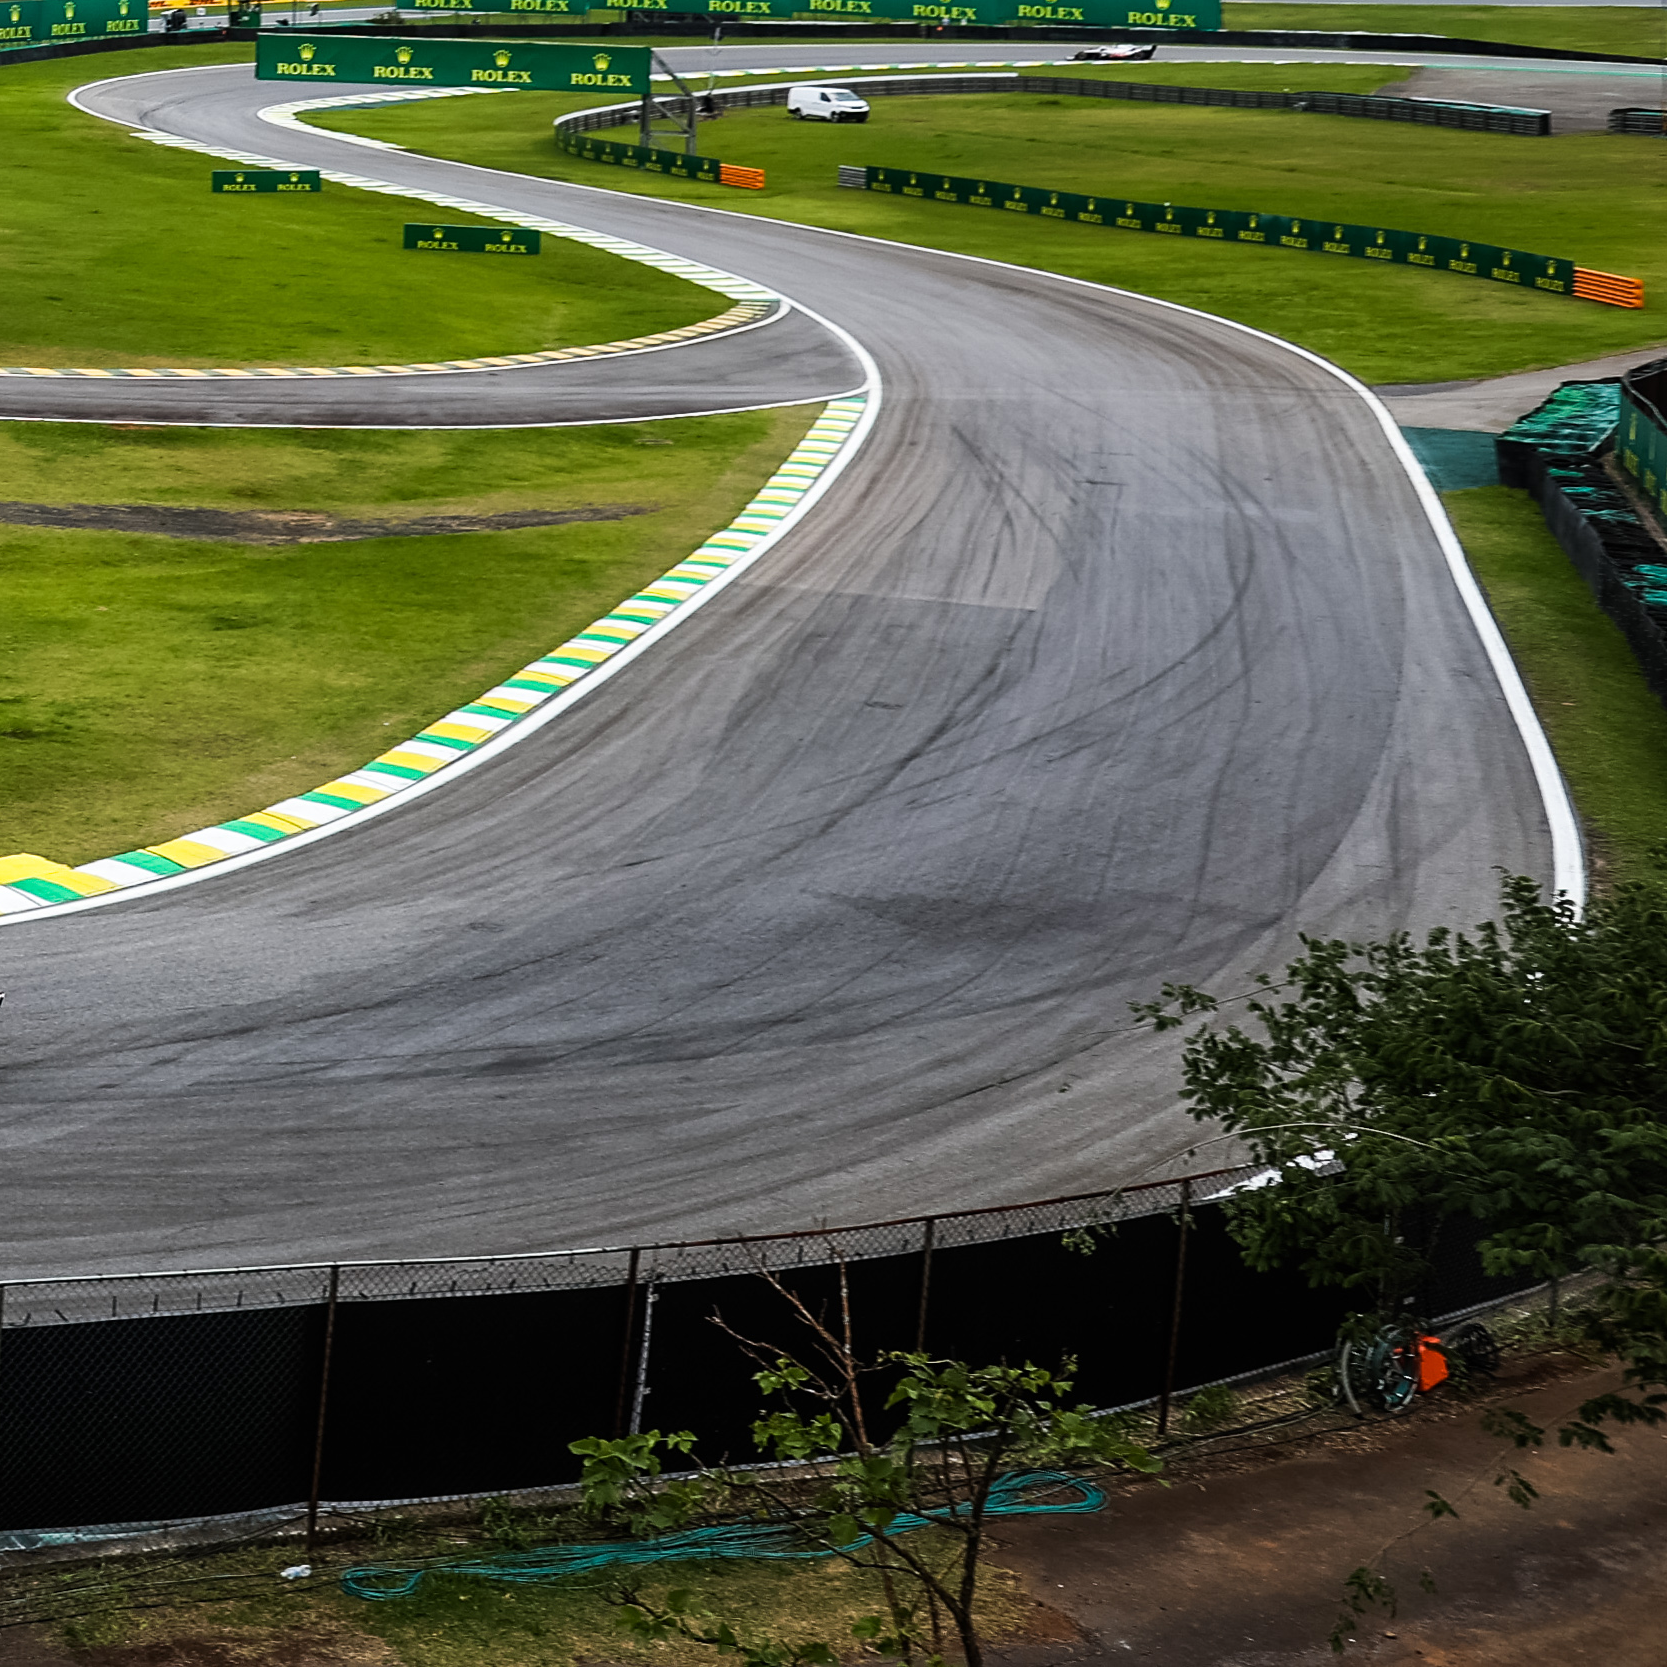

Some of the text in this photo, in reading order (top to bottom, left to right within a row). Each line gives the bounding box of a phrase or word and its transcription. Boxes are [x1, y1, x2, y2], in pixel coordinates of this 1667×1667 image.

[708, 0, 772, 14] ROLEX
[912, 4, 977, 20] ROLEX
[1017, 4, 1085, 20] ROLEX
[106, 19, 140, 32] ROLEX
[1127, 11, 1197, 28] ROLEX
[51, 22, 86, 36] ROLEX
[277, 62, 336, 76] ROLEX
[373, 66, 434, 80] ROLEX
[471, 69, 532, 83] ROLEX
[570, 73, 633, 87] ROLEX
[277, 183, 311, 191] ROLEX
[417, 240, 458, 250] ROLEX
[485, 244, 527, 253] ROLEX
